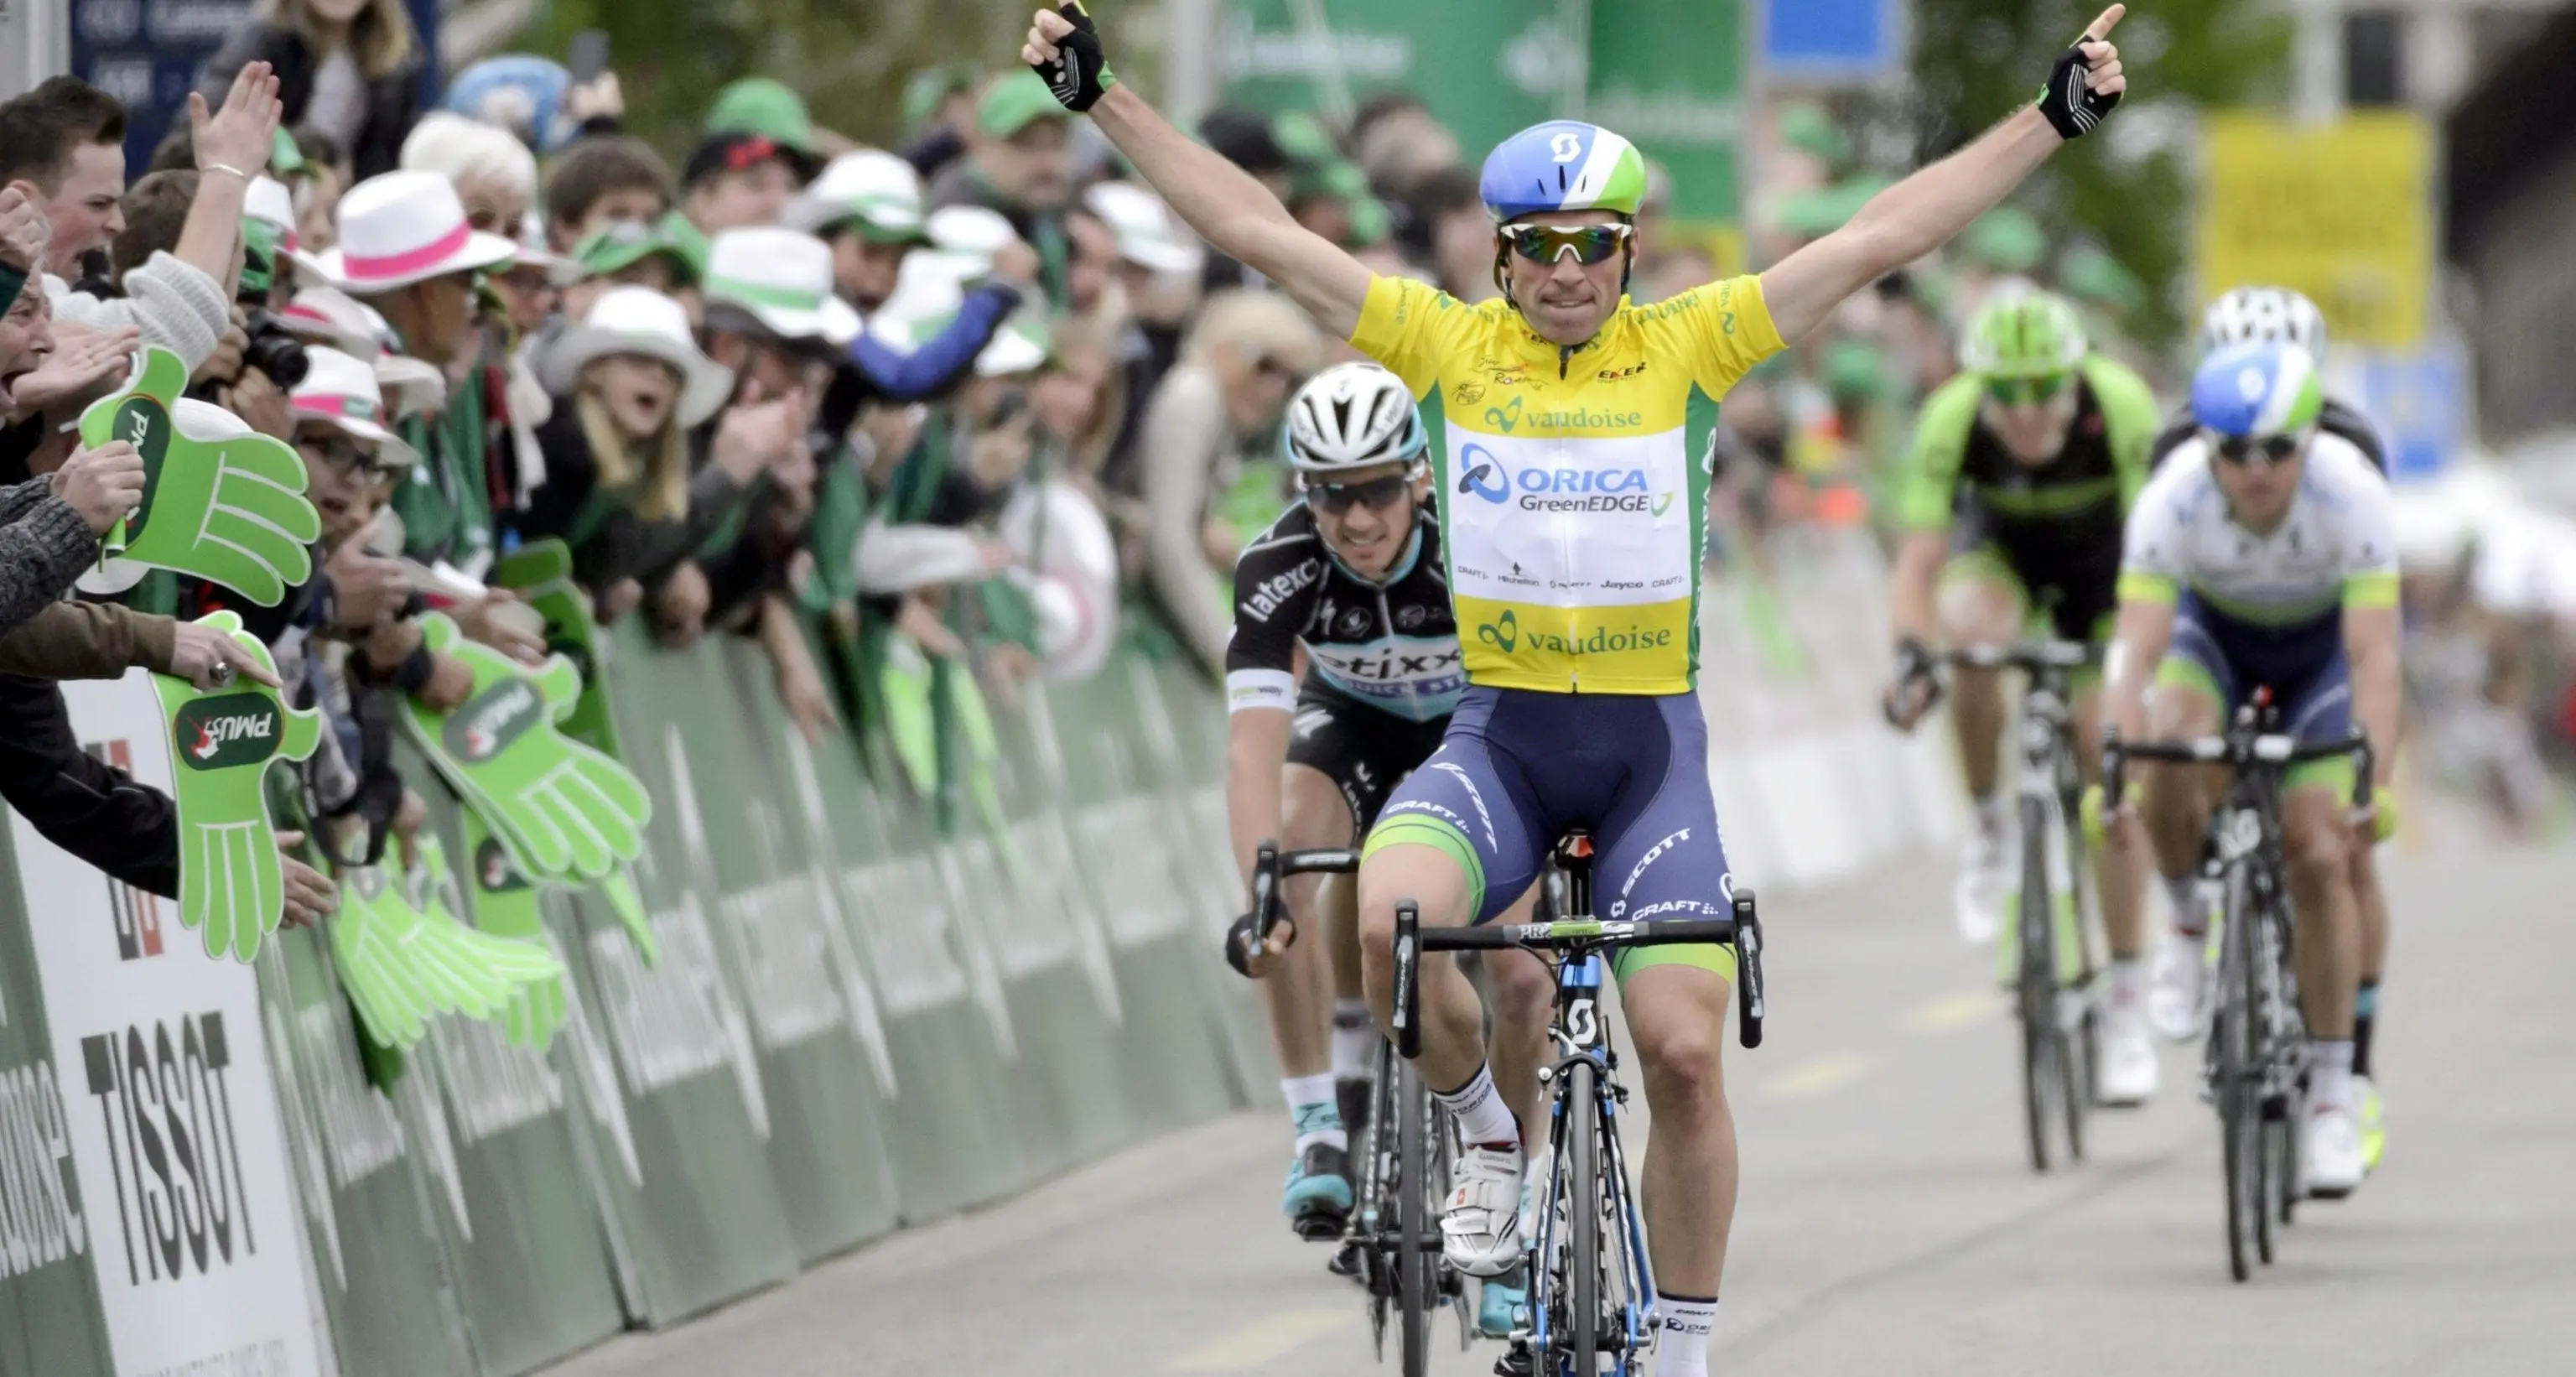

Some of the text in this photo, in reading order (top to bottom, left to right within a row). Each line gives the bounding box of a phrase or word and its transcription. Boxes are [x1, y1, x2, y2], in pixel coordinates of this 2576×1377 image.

[1526, 407, 1643, 429] vaudoise
[1517, 468, 1649, 493] ORICA
[1519, 495, 1649, 512] GreenEDGE
[1600, 579, 1644, 590] Jayco
[1526, 625, 1671, 656] vaudoise
[1386, 800, 1458, 818] CRAFT
[1622, 828, 1690, 898] SCOTT
[1632, 900, 1701, 922] CRAFT
[81, 1011, 256, 1286] TISSOT
